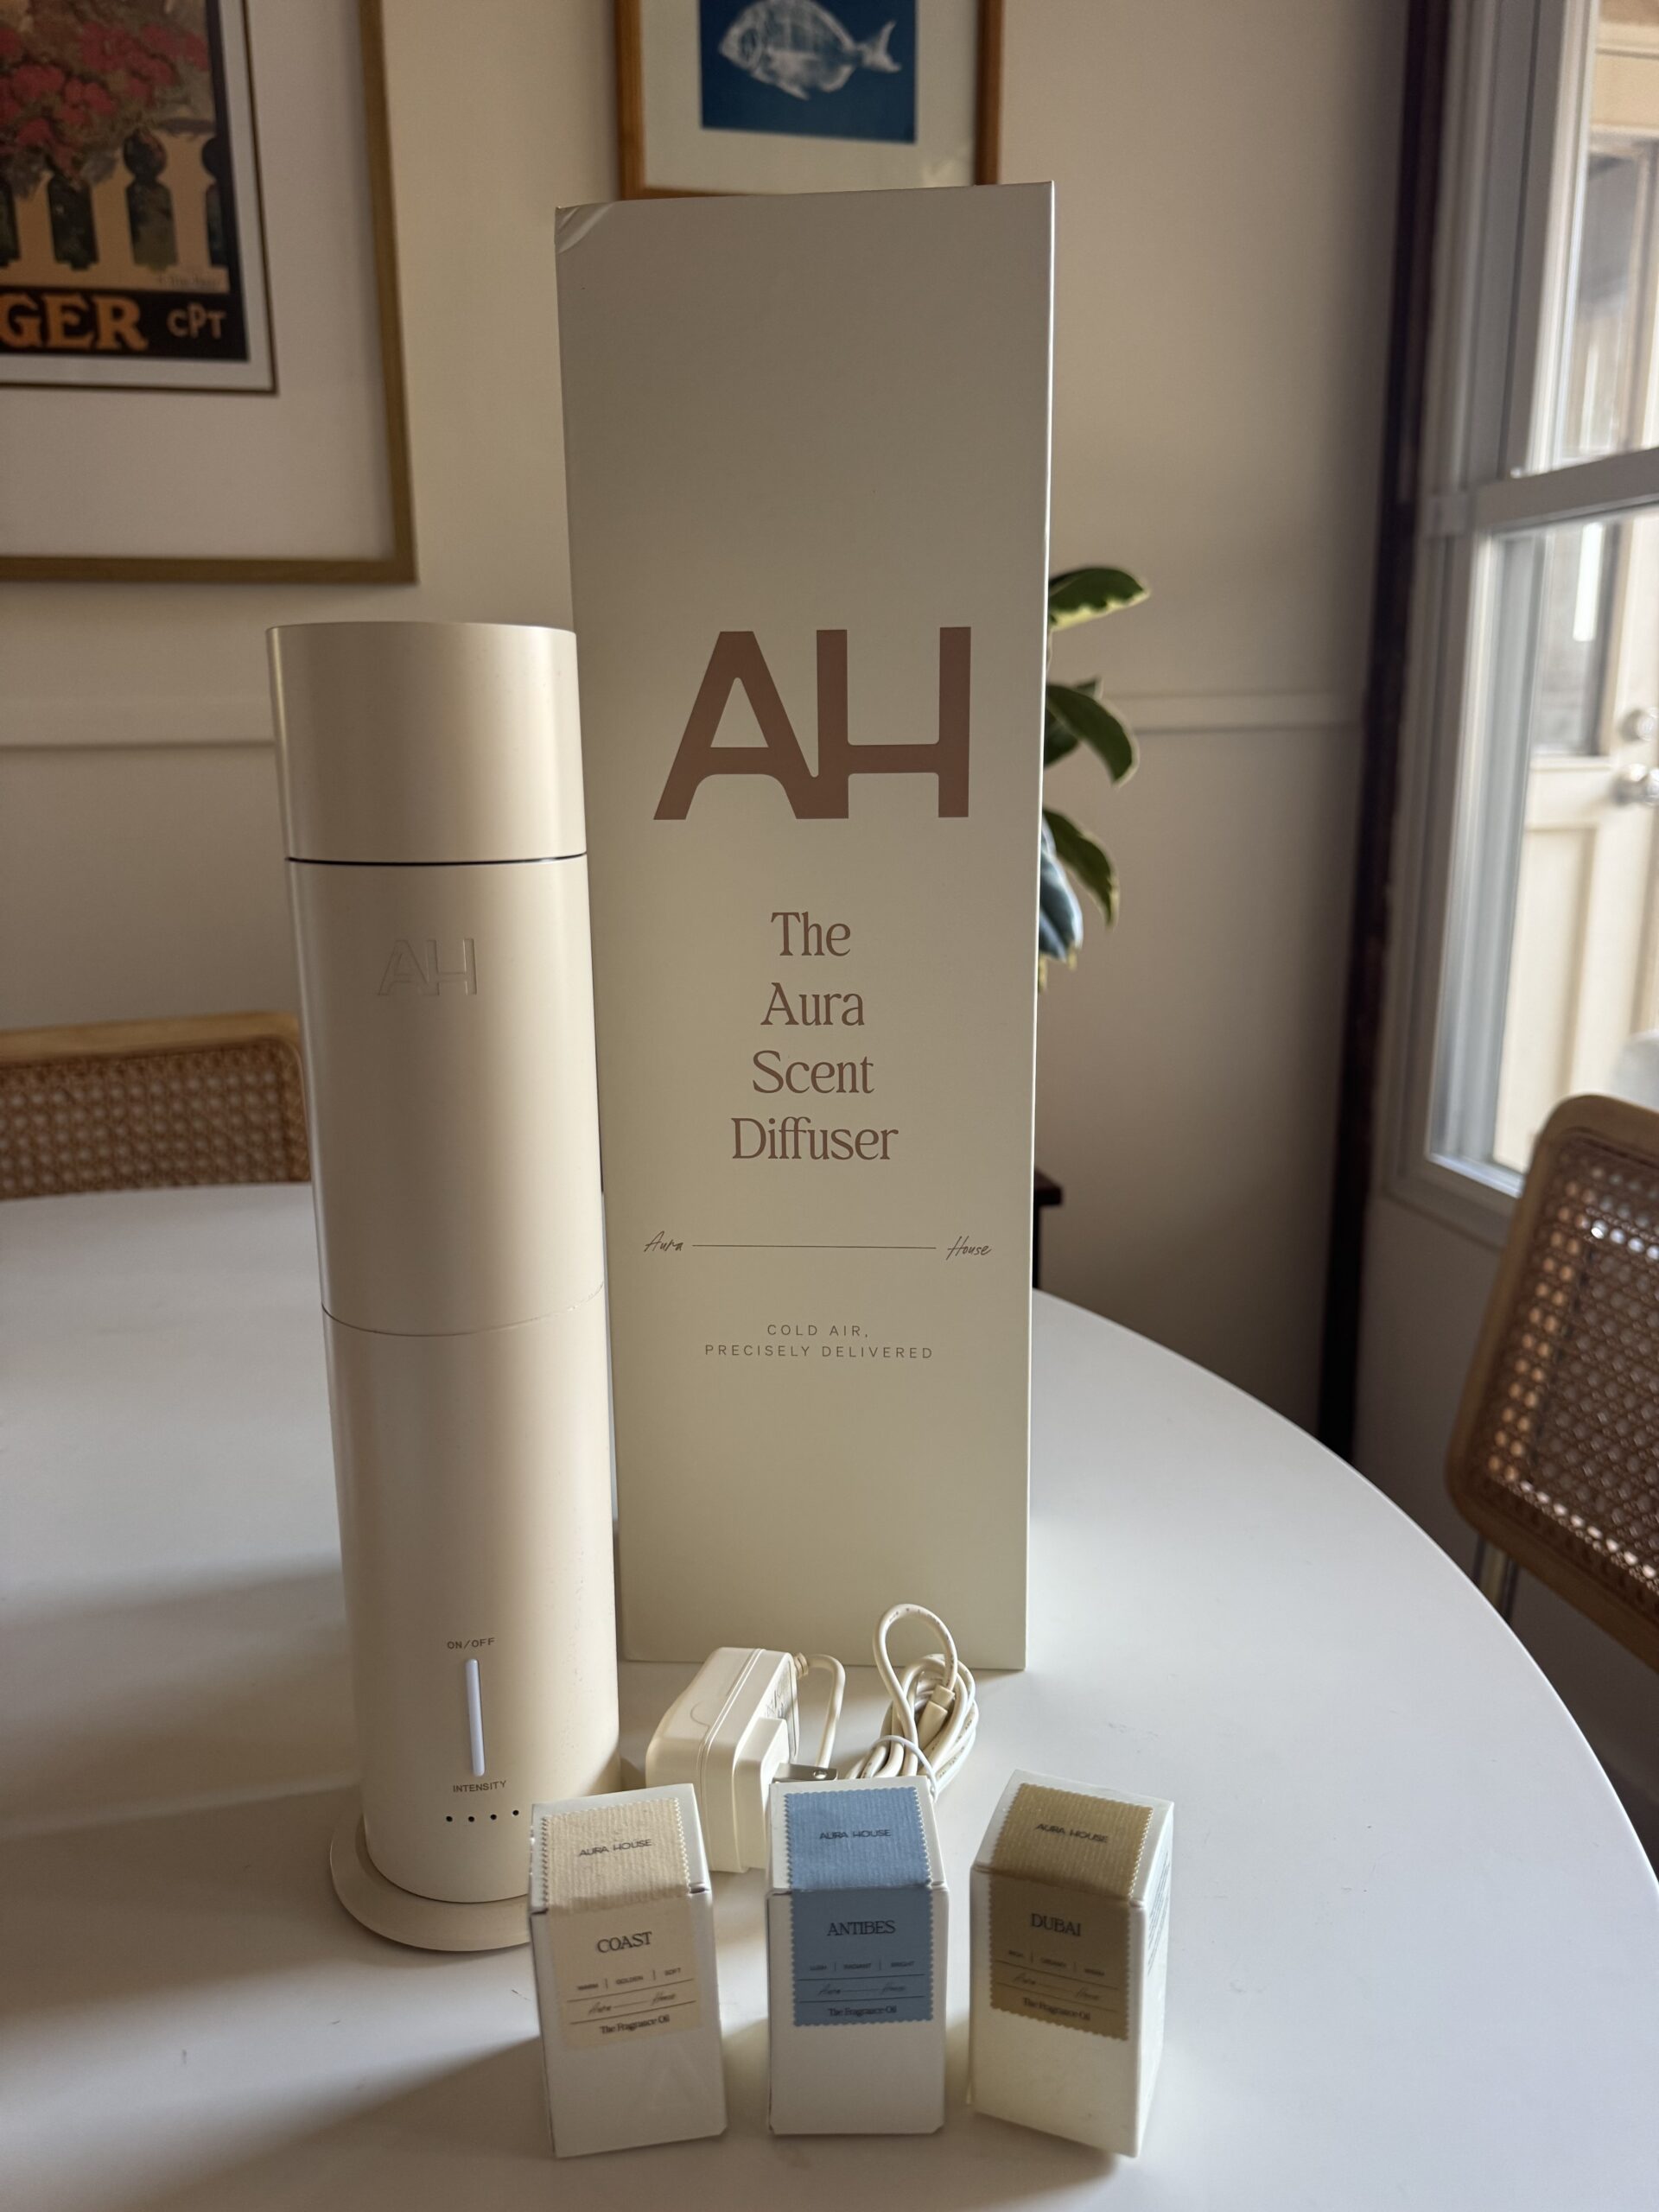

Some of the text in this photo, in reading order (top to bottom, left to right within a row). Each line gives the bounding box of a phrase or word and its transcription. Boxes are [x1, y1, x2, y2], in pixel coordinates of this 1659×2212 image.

[0, 292, 149, 351] GER
[653, 626, 971, 820] AH
[770, 912, 851, 957] The
[378, 938, 478, 995] AH
[760, 982, 866, 1026] Aura
[752, 1049, 875, 1094] Scent
[731, 1116, 899, 1160] Diffuser
[644, 1230, 992, 1260] Aura House
[767, 1324, 869, 1338] COLD AIR,
[705, 1344, 933, 1358] PRECISELY DELIVERED
[447, 1637, 496, 1649] ON/OFF
[452, 1780, 507, 1793] INTENSITY
[819, 1828, 892, 1840] AURA HOUSE
[1034, 1823, 1109, 1843] AURA HOUSE
[579, 1839, 652, 1857] AURA HOUSE
[827, 1920, 896, 1936] ANTIBES
[1030, 1912, 1082, 1937] DUBAI
[596, 1931, 652, 1954] COAST
[600, 2014, 671, 2035] The Fragrance Oil
